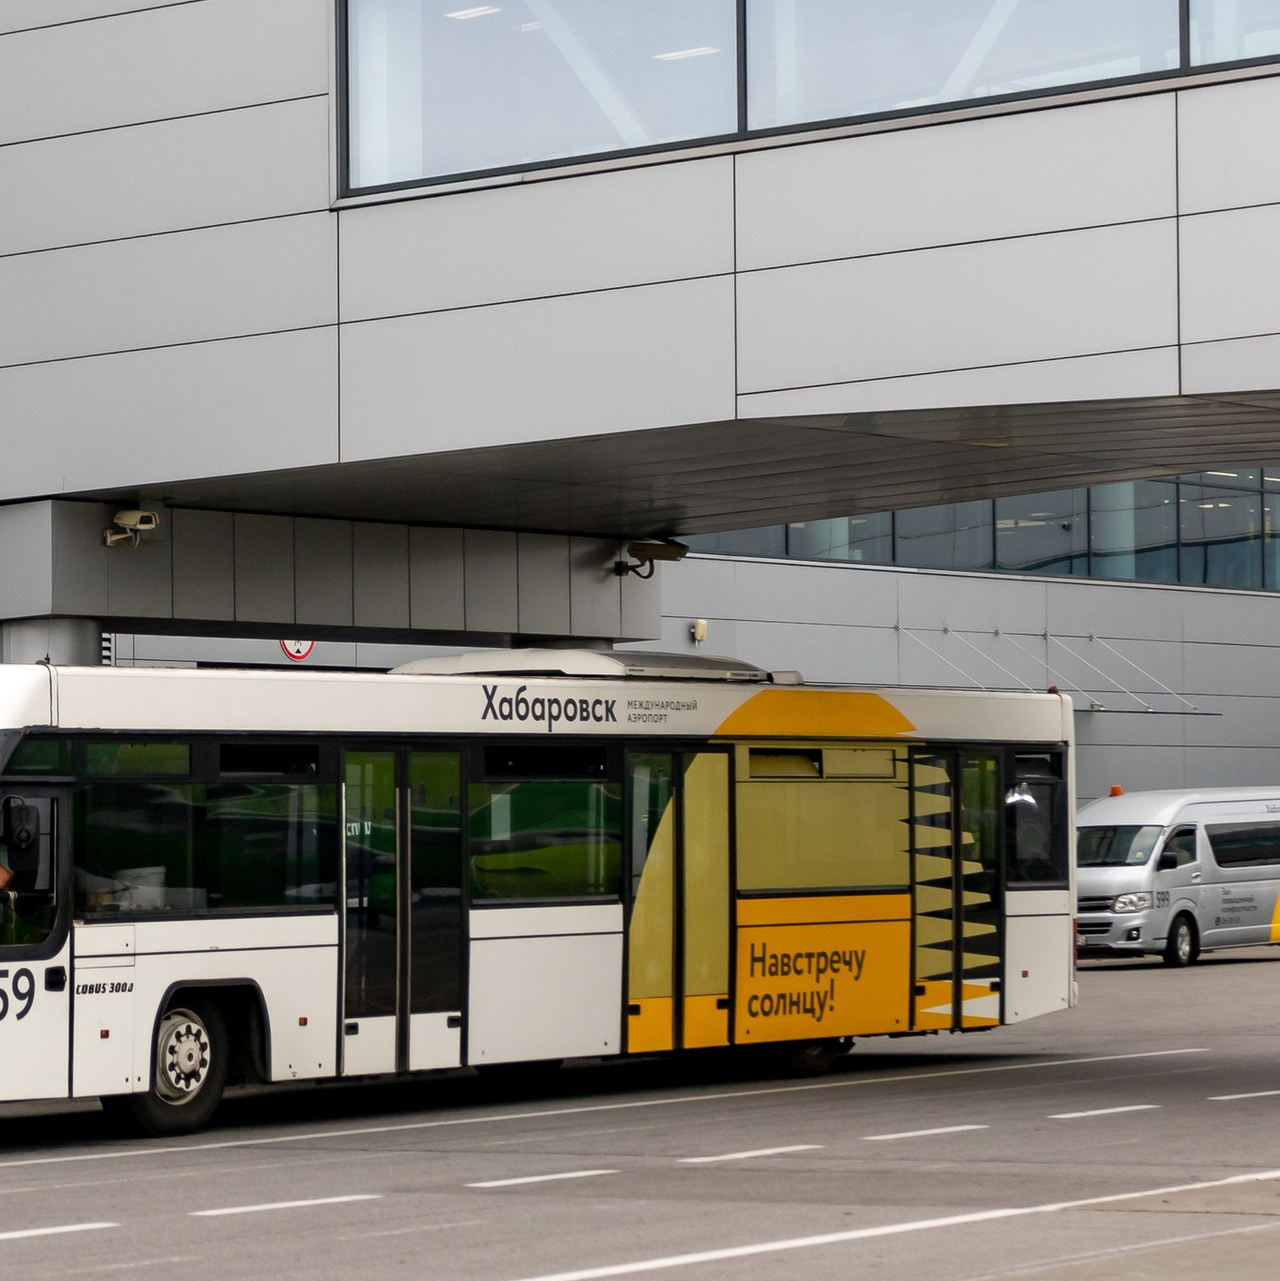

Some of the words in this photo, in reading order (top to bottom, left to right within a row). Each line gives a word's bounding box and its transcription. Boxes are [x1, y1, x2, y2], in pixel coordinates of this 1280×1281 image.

[481, 684, 618, 733] Хабаровск
[627, 700, 698, 711] МЕЖДУНАРОДНЫЙ
[627, 713, 668, 723] АЭРОПОРТ
[749, 942, 866, 984] Навстречу
[76, 983, 107, 995] COBUS
[747, 977, 835, 1023] солнцу!
